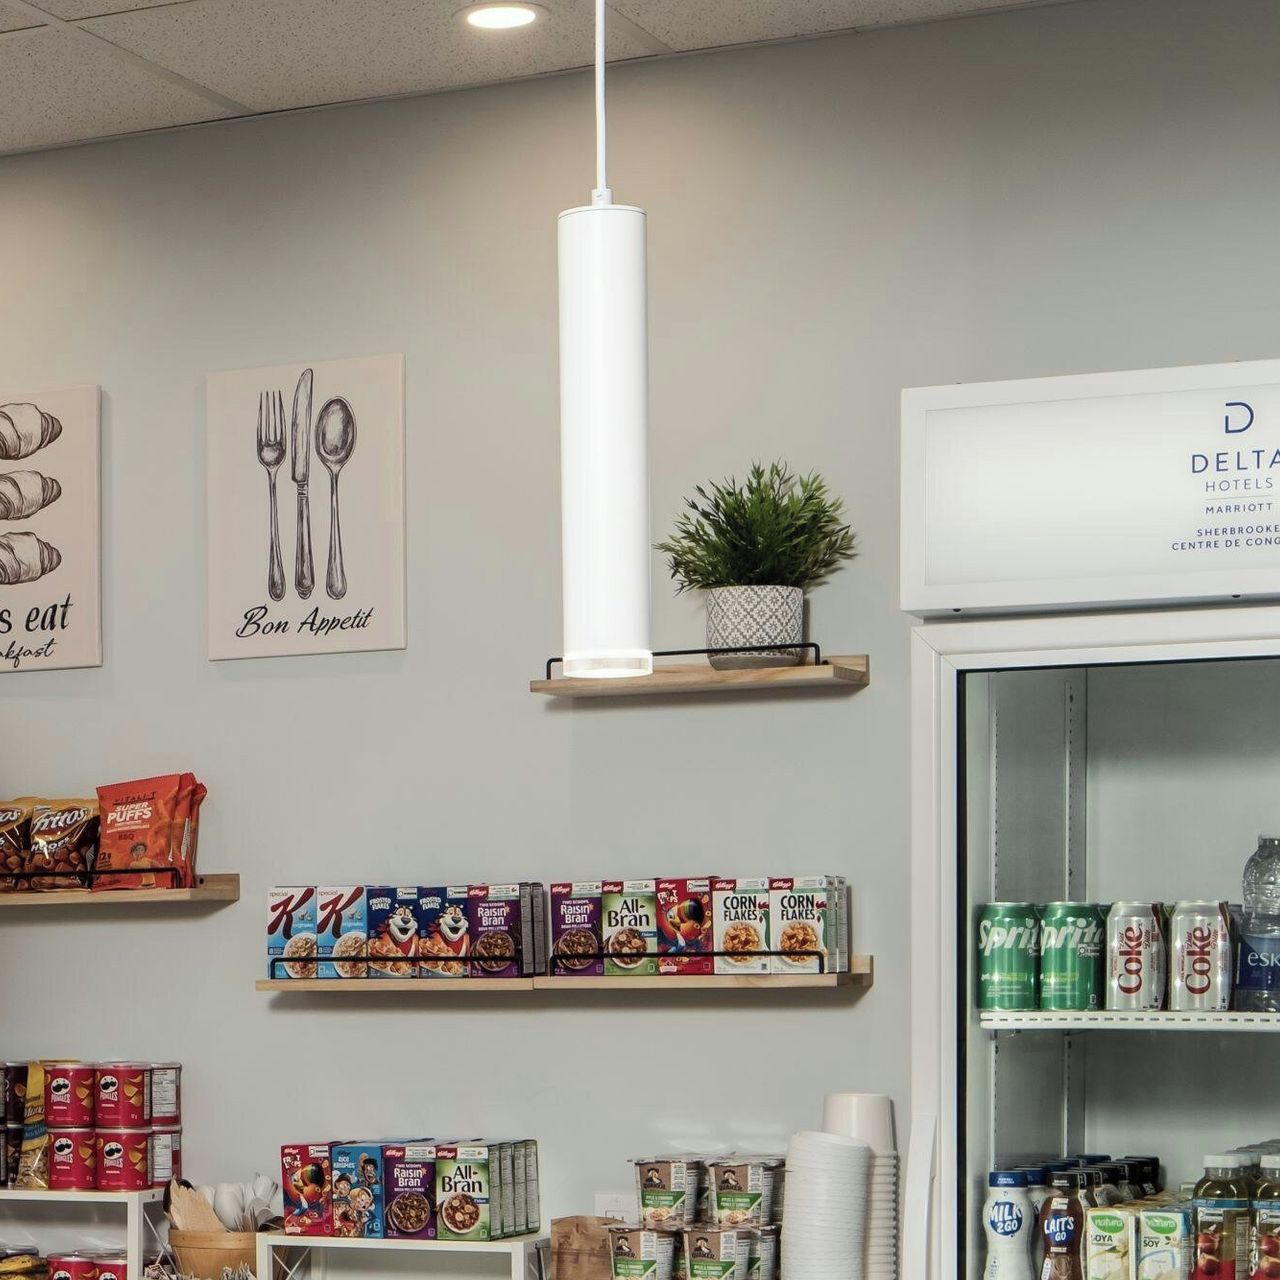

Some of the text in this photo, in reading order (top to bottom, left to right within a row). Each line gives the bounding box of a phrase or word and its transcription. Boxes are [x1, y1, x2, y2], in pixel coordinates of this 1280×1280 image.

[1205, 477, 1273, 492] HOTELS
[1205, 502, 1273, 515] MARRIOTT
[1197, 524, 1280, 537] SHERBROOKE
[1171, 538, 1219, 551] CENTRE
[1225, 538, 1240, 548] DE
[26, 592, 74, 633] eat
[236, 605, 376, 638] Bon Appetit
[115, 801, 148, 812] SUPER
[32, 808, 87, 835] Fritos
[107, 807, 152, 825] PUFFS
[620, 898, 645, 913] All-
[723, 895, 757, 910] CORN
[780, 894, 814, 909] CORN
[267, 887, 315, 940] K
[317, 886, 364, 939] K
[477, 907, 506, 917] Raisin
[560, 904, 590, 915] Raisin
[723, 909, 758, 921] FLAKES
[781, 908, 816, 921] FLAKES
[482, 916, 504, 926] Bran
[565, 913, 587, 923] Bran
[608, 910, 650, 928] Bran
[1118, 926, 1142, 994] Coke
[1185, 926, 1211, 994] Coke
[394, 1168, 422, 1178] Raisin
[454, 1165, 478, 1180] All-
[398, 1177, 420, 1187] Bran
[442, 1175, 482, 1193] Bran
[989, 1202, 1022, 1222] MILK
[997, 1221, 1018, 1233] 2GO
[1044, 1215, 1074, 1234] LAIT'S
[1055, 1232, 1066, 1242] GO
[1143, 1240, 1160, 1248] SOY
